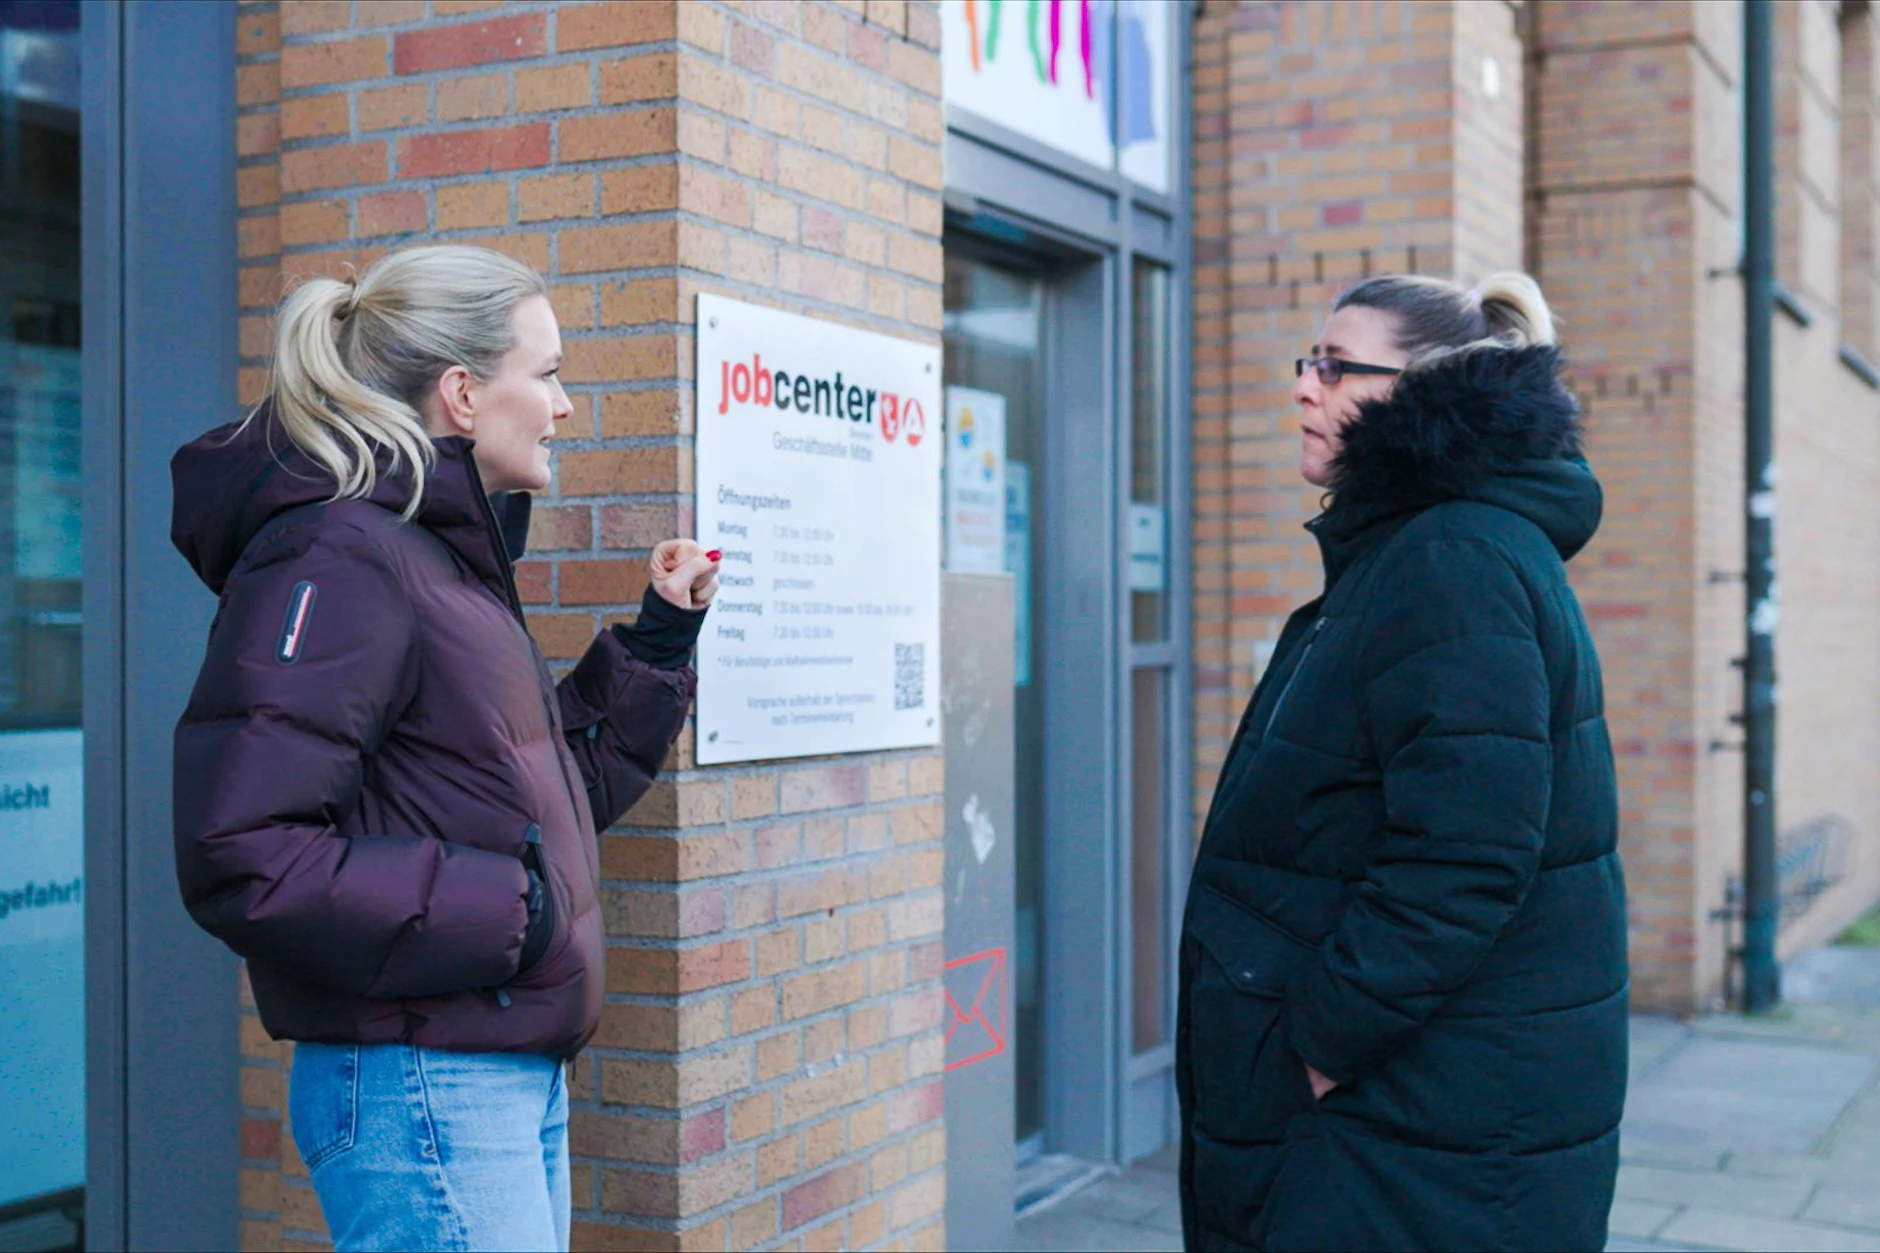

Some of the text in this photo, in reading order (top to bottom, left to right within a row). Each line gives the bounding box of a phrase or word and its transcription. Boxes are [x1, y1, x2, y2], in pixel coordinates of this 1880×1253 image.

[719, 352, 877, 424] jobcenter
[773, 430, 848, 459] Geschäftsstelle
[850, 442, 873, 462] Mitte
[717, 484, 792, 512] Öffnungszeiten
[717, 520, 747, 539] Montag
[718, 573, 755, 588] Mittwoch
[717, 598, 763, 616] Donnerstag
[717, 624, 746, 642] Freitag
